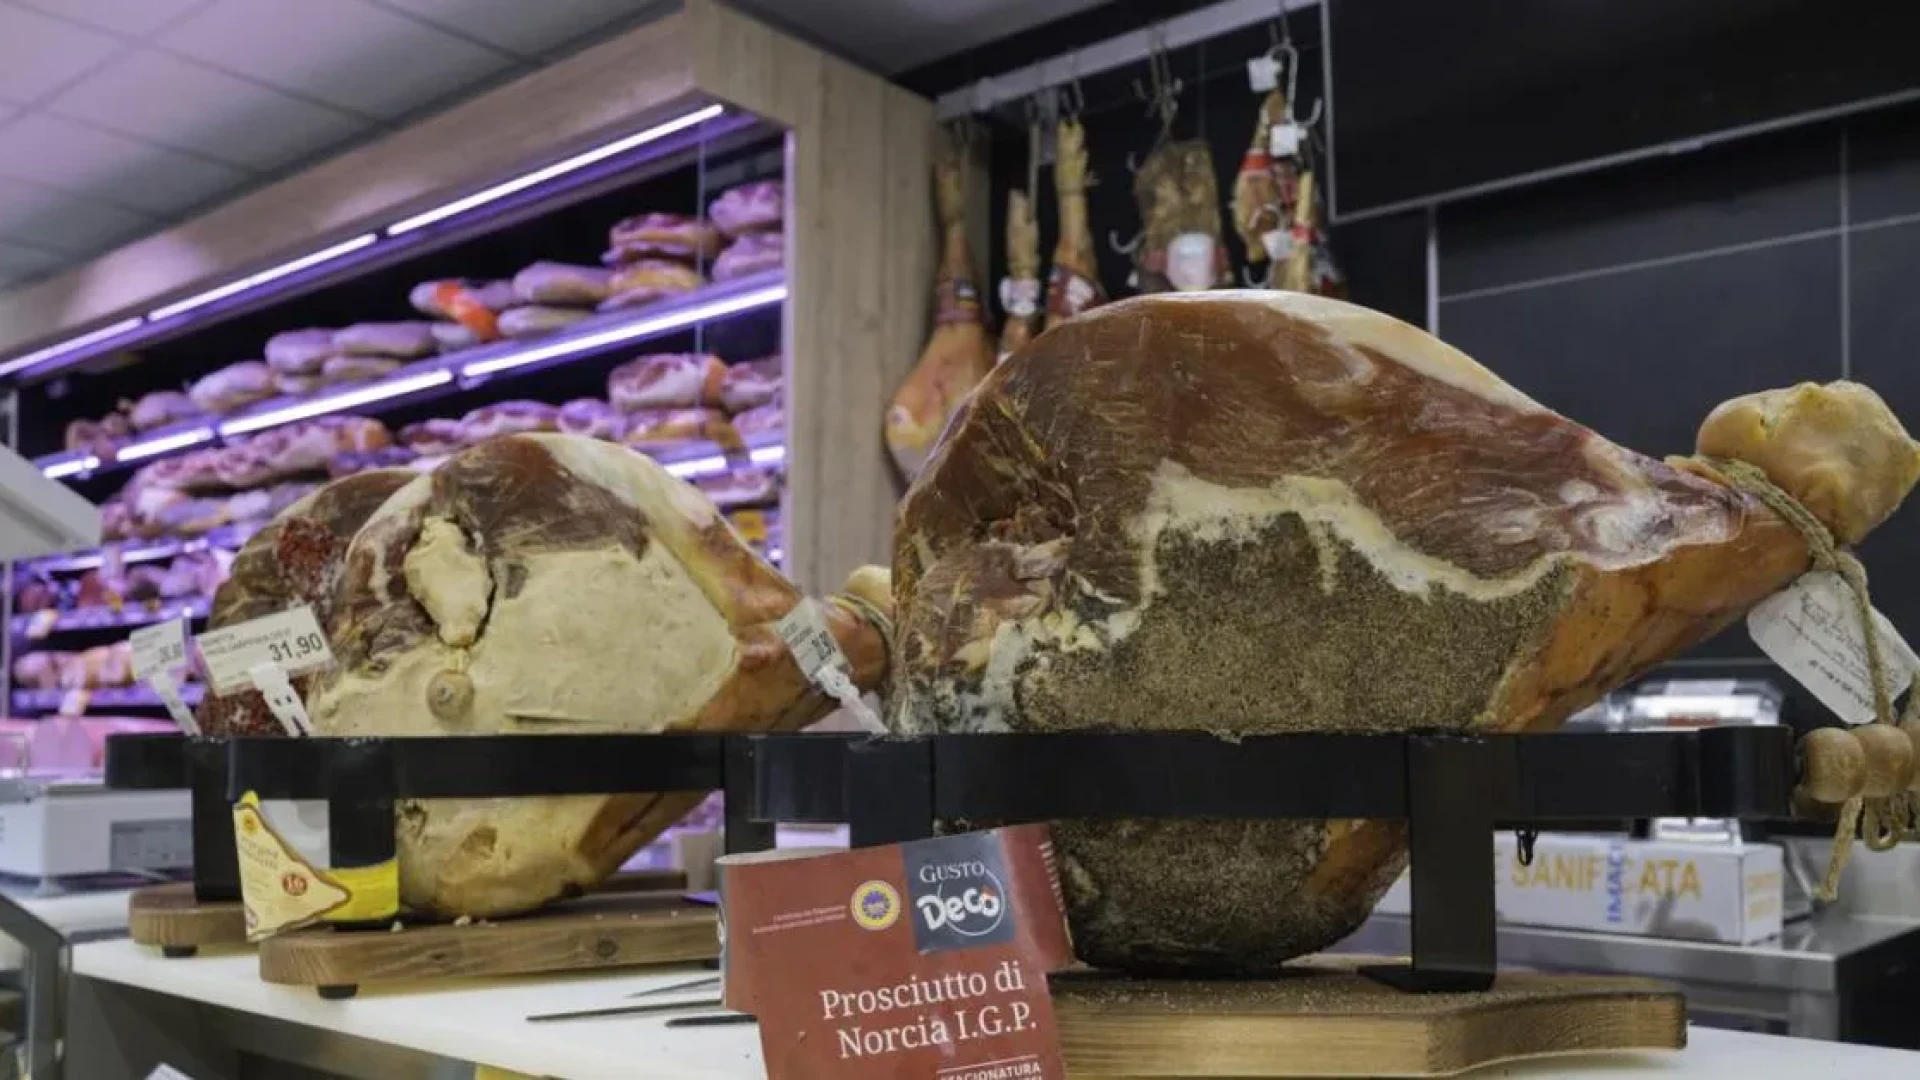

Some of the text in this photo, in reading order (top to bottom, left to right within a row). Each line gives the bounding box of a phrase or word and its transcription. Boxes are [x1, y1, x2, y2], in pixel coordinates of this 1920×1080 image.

[268, 632, 323, 662] 31,90
[920, 861, 985, 883] GUSTO
[819, 960, 1026, 1019] Prosciutto di
[836, 1001, 1037, 1059] Norcia I.G.P.
